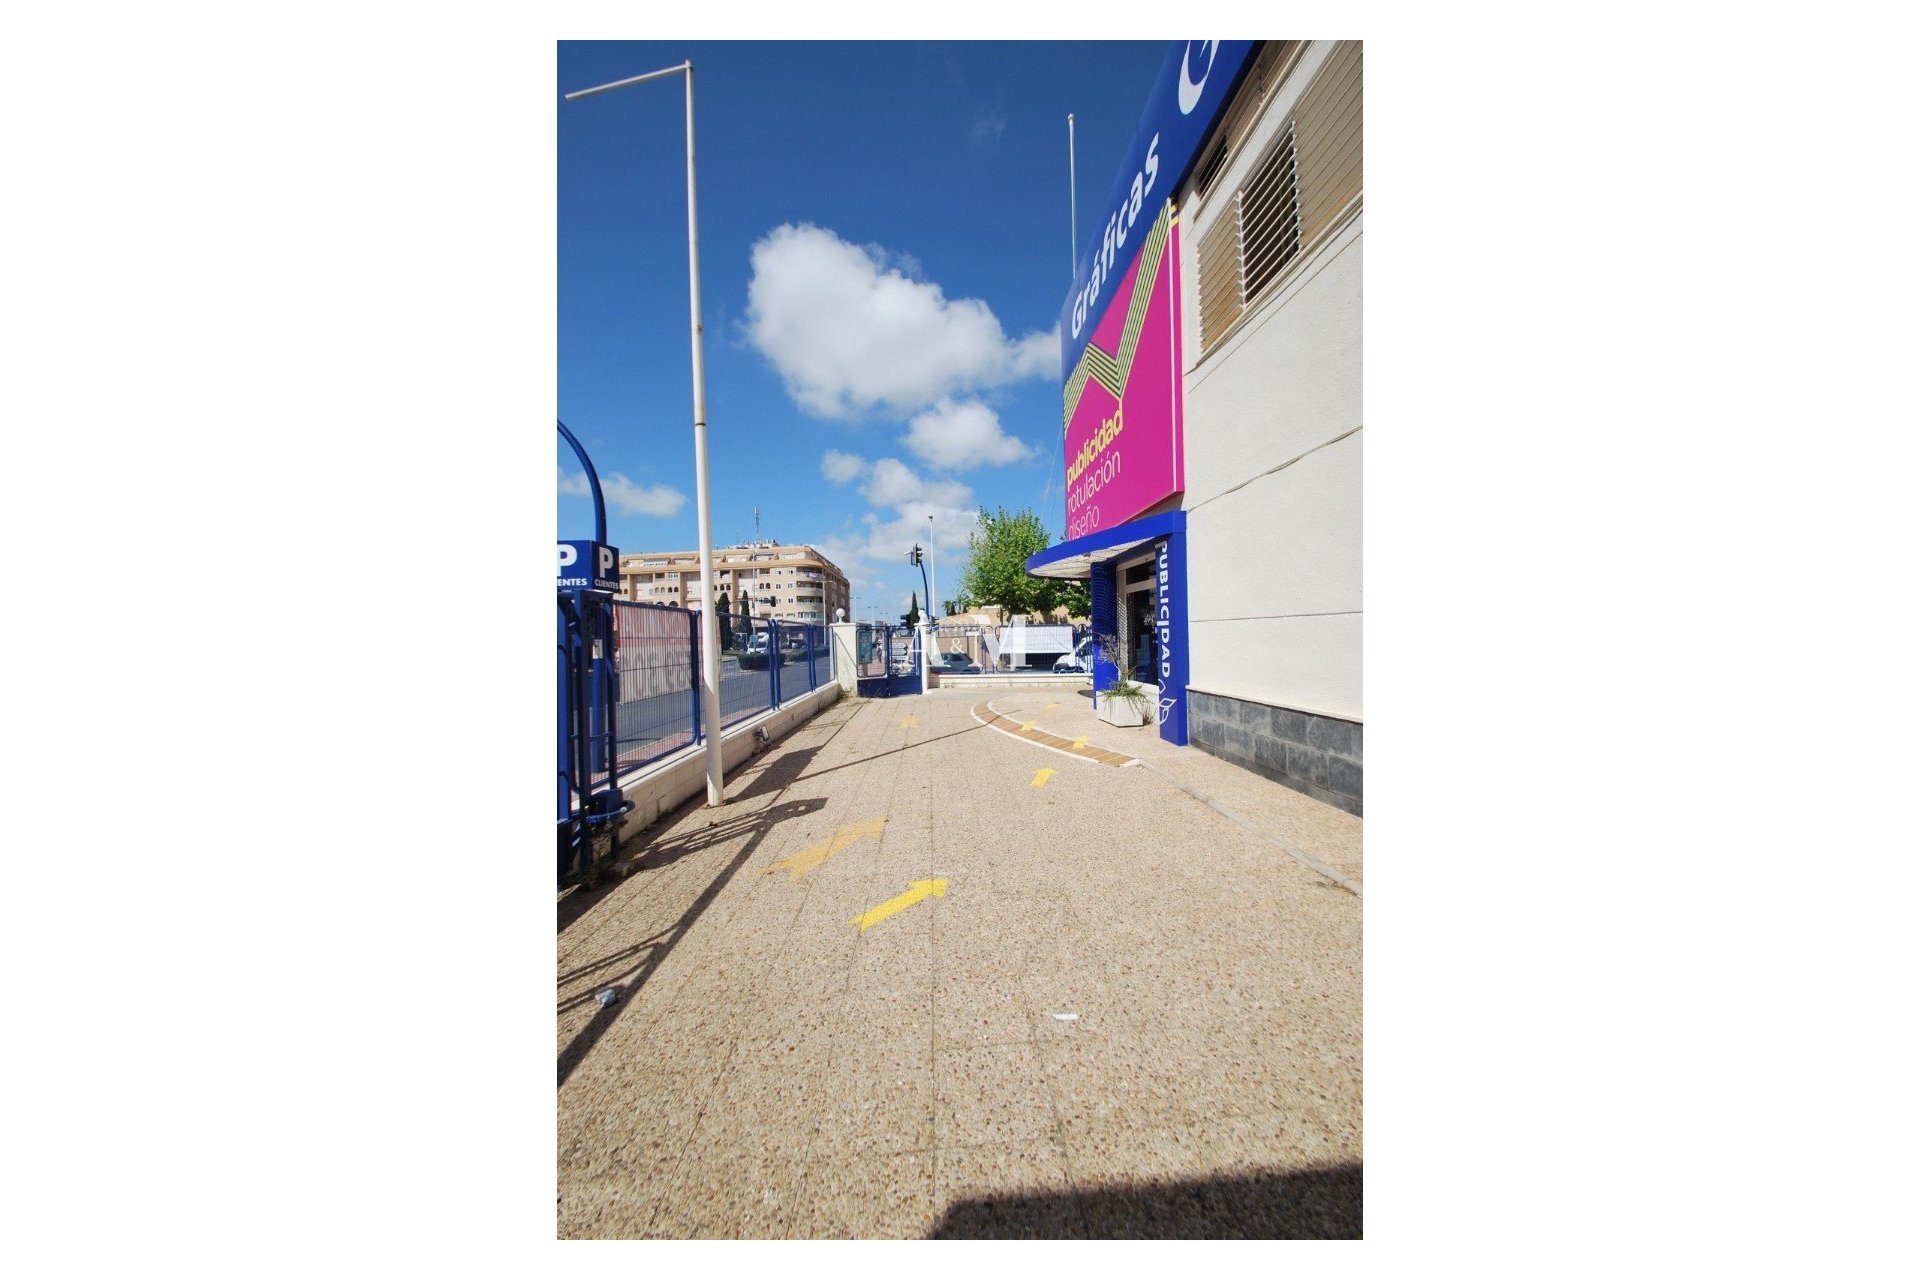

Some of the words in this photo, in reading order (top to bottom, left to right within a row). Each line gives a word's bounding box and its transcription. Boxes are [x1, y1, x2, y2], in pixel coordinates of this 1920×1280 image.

[1072, 132, 1160, 340] Gráficas
[1067, 399, 1123, 492] publicidad
[1067, 450, 1121, 516] rotulación
[557, 544, 577, 577] P
[594, 579, 618, 589] CLIENTES
[599, 546, 613, 578] P
[1155, 540, 1171, 678] PUBLICIDAD
